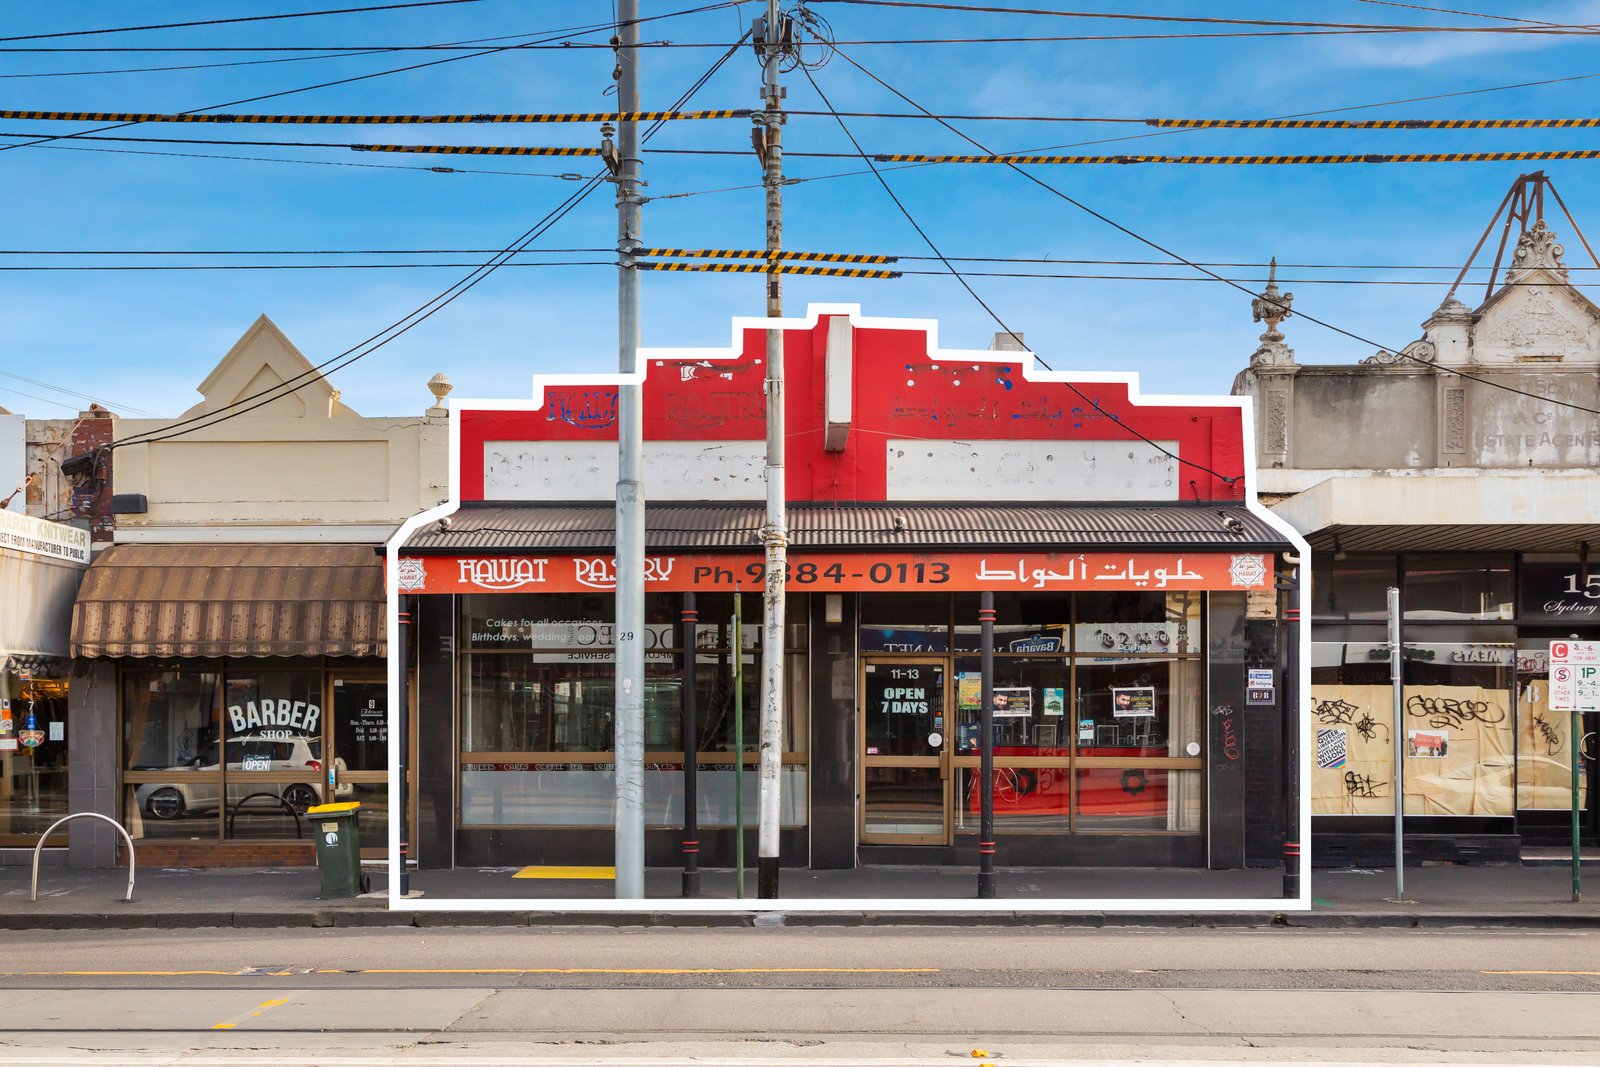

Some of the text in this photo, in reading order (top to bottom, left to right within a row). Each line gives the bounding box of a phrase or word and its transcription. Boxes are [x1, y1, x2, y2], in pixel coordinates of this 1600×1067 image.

[37, 521, 86, 547] KNITWEAR
[69, 548, 85, 560] PUBLIC
[457, 558, 549, 590] HAWAT
[573, 557, 675, 589] PASRY
[1094, 557, 1204, 588] حلويات
[1563, 574, 1600, 599] 15
[1543, 600, 1598, 616] Sydney
[486, 618, 518, 628] Cakes
[520, 617, 534, 628] for
[537, 618, 550, 628] all
[619, 631, 635, 642] 29
[890, 668, 920, 680] 11-13
[1581, 667, 1596, 679] 1P
[884, 687, 925, 699] OPEN
[881, 701, 929, 714] 7 DAYS
[227, 699, 321, 733] BARBER
[259, 730, 293, 740] SHOP
[1318, 730, 1338, 744] QUEER
[1318, 740, 1346, 760] WITHOUT
[1318, 747, 1346, 767] PRISONS
[245, 760, 268, 770] OPEN
